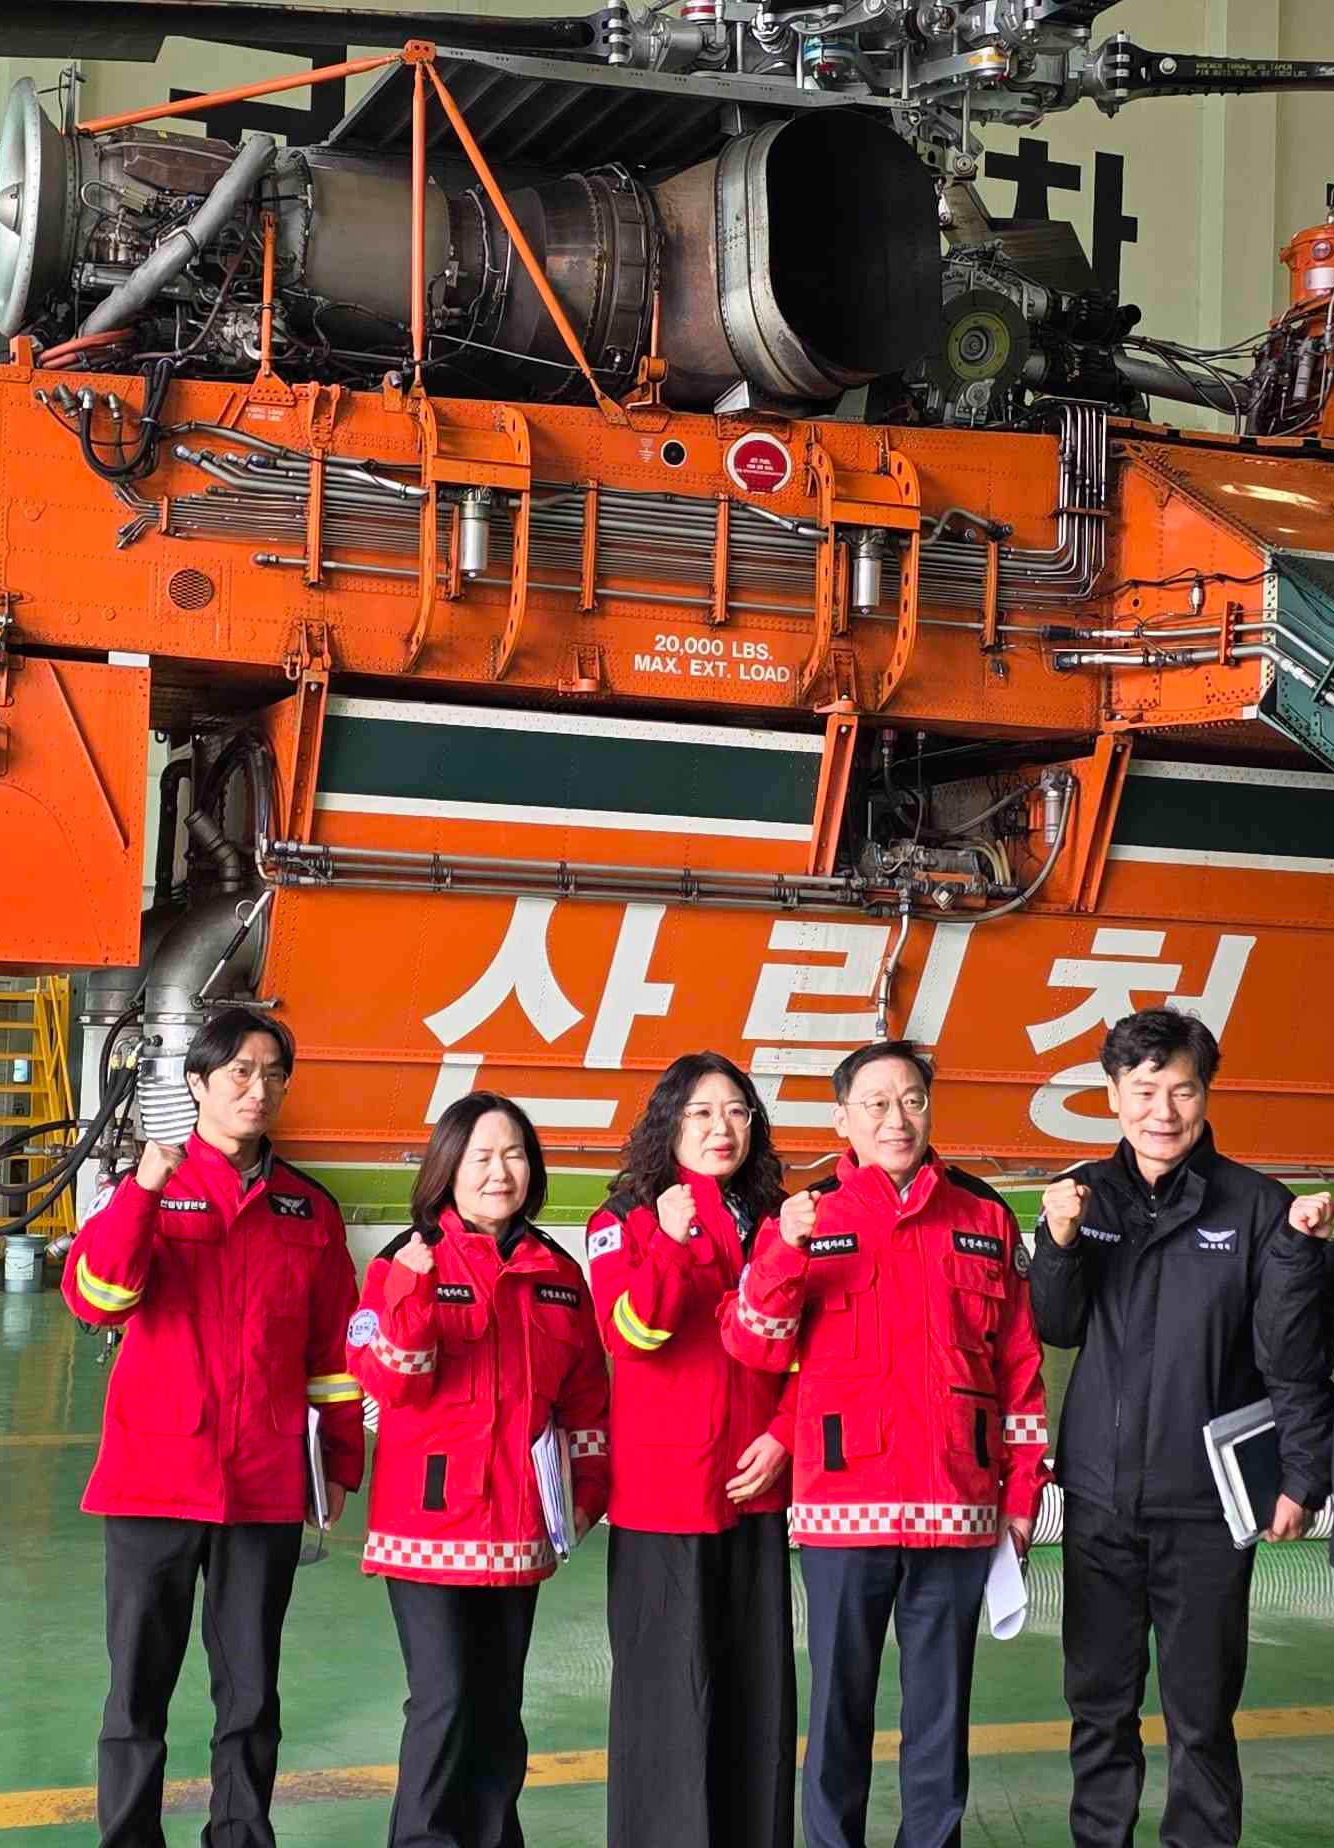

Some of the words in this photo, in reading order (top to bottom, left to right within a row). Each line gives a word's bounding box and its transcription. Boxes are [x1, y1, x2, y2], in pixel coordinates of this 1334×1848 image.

[654, 634, 724, 657] 20,000
[732, 641, 774, 661] LBS.
[634, 654, 682, 675] MAX.
[690, 660, 732, 679] EXT.
[739, 663, 790, 682] LOAD
[423, 897, 1256, 1143] 산림청
